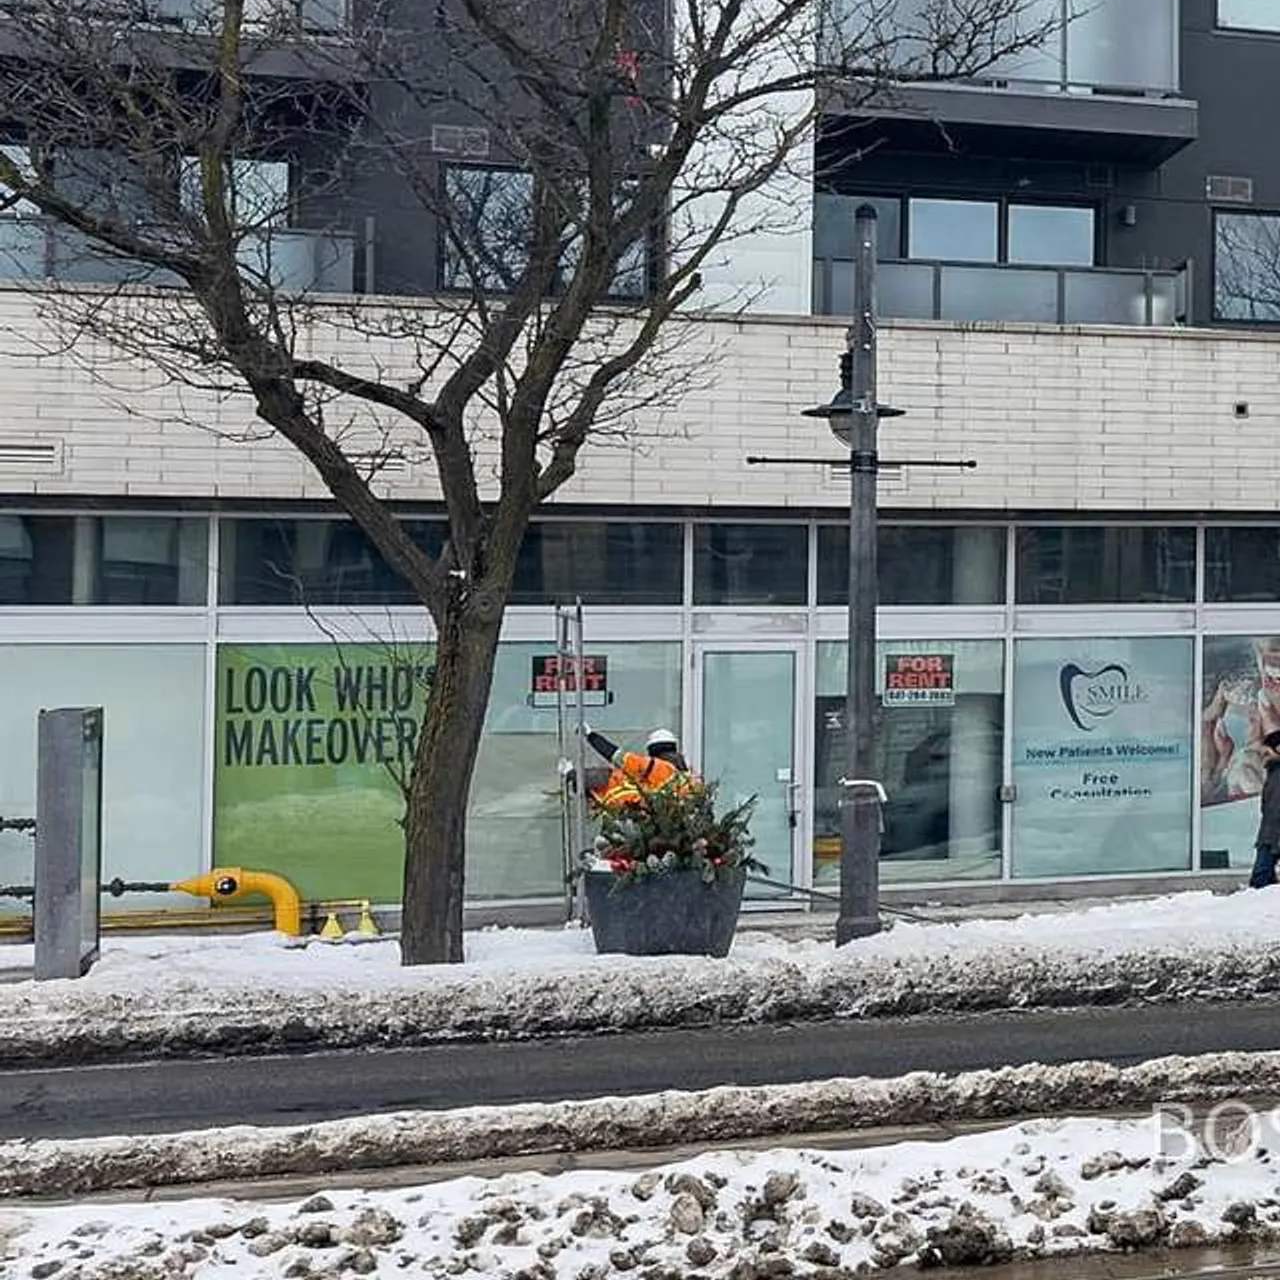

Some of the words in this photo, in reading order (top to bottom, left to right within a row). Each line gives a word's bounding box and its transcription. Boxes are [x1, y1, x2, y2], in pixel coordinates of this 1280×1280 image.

[896, 657, 943, 672] FOR
[889, 672, 951, 688] RENT
[225, 667, 315, 713] LOOK
[1026, 748, 1056, 760] New
[1058, 746, 1113, 758] Patients
[1082, 772, 1119, 785] Free
